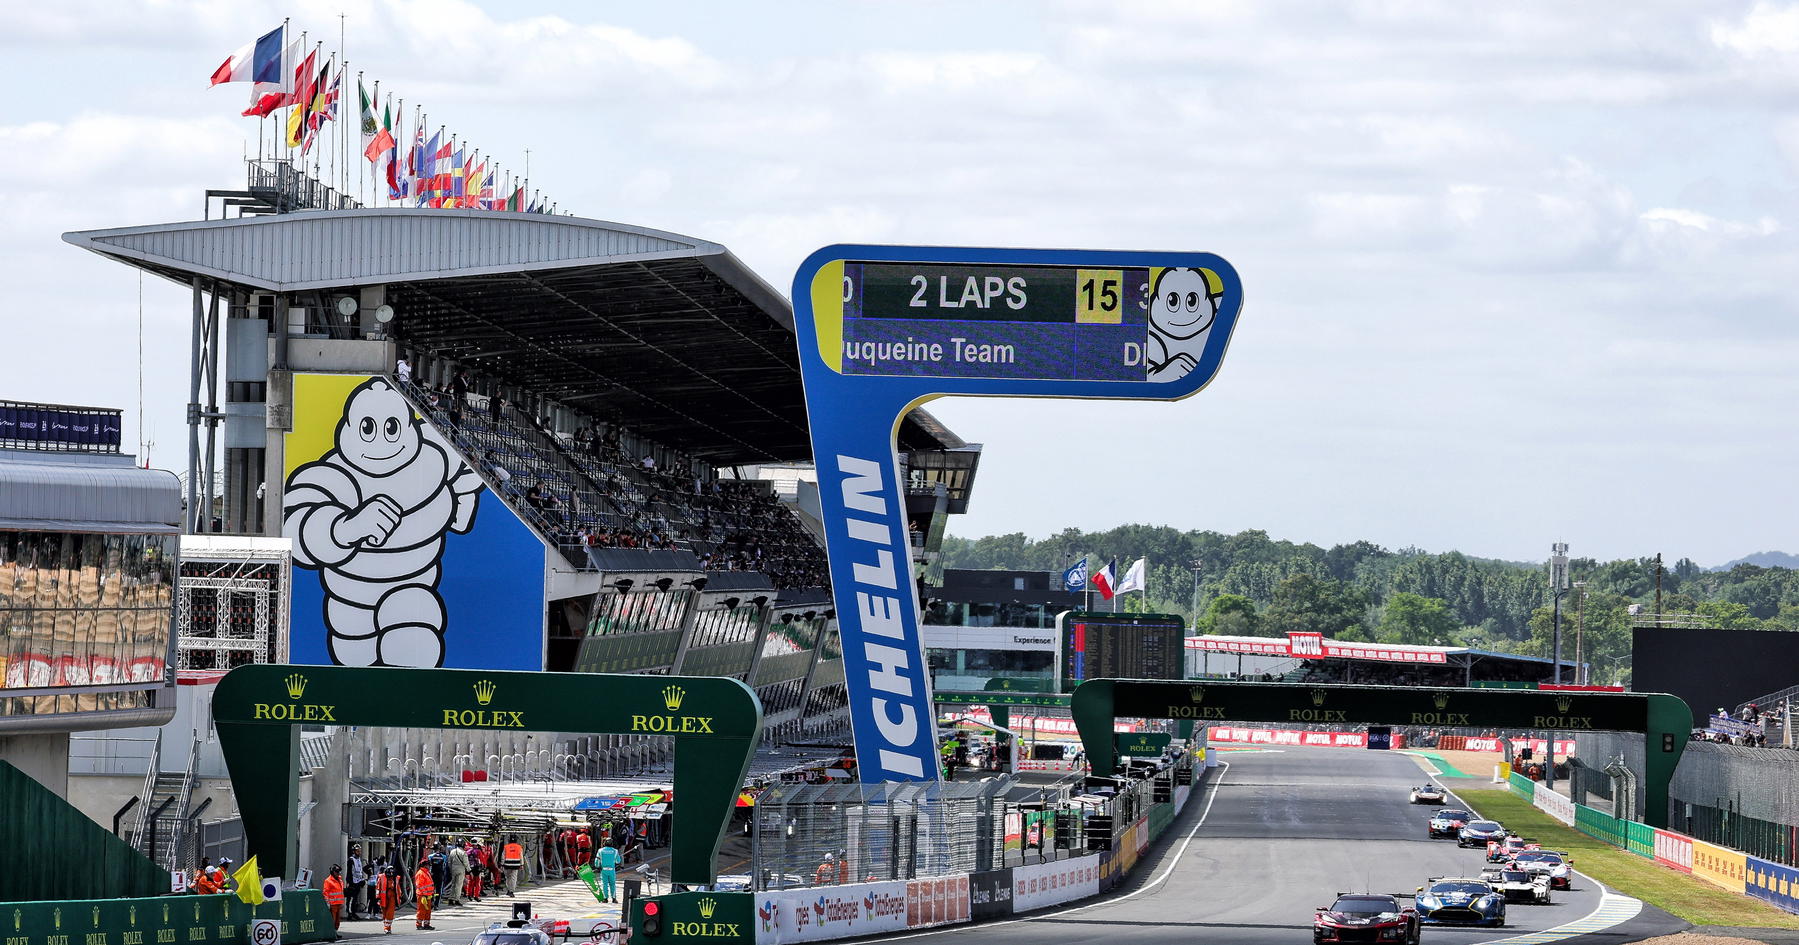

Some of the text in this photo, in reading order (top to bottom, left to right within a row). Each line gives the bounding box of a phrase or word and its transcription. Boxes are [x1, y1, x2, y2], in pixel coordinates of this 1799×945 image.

[909, 275, 928, 307] 2
[939, 275, 1027, 310] LAPS
[1082, 278, 1118, 312] 15
[843, 336, 943, 366] uqueine
[951, 337, 1015, 363] Team
[1013, 635, 1052, 645] Experience
[1291, 635, 1322, 655] MOTUL
[253, 703, 336, 722] ROLEX
[442, 709, 525, 727] ROLEX
[1168, 705, 1225, 719] ROLEX
[1289, 709, 1347, 722] ROLEX
[1411, 712, 1470, 725] ROLEX
[631, 714, 714, 733] ROLEX
[1534, 715, 1592, 729] ROLEX
[1276, 732, 1300, 744] MOTUL
[1306, 732, 1331, 744] MOTUL
[1335, 734, 1362, 745] MOTUL
[1465, 739, 1496, 750] MOTUL
[86, 933, 107, 945] ROLEX
[123, 931, 143, 945] ROLEX
[157, 928, 176, 943] ROLEX
[189, 927, 206, 941] ROLEX
[218, 925, 236, 939] ROLEX
[300, 919, 315, 933] ROLEX
[256, 928, 274, 940] 60
[672, 921, 740, 937] ROLEX
